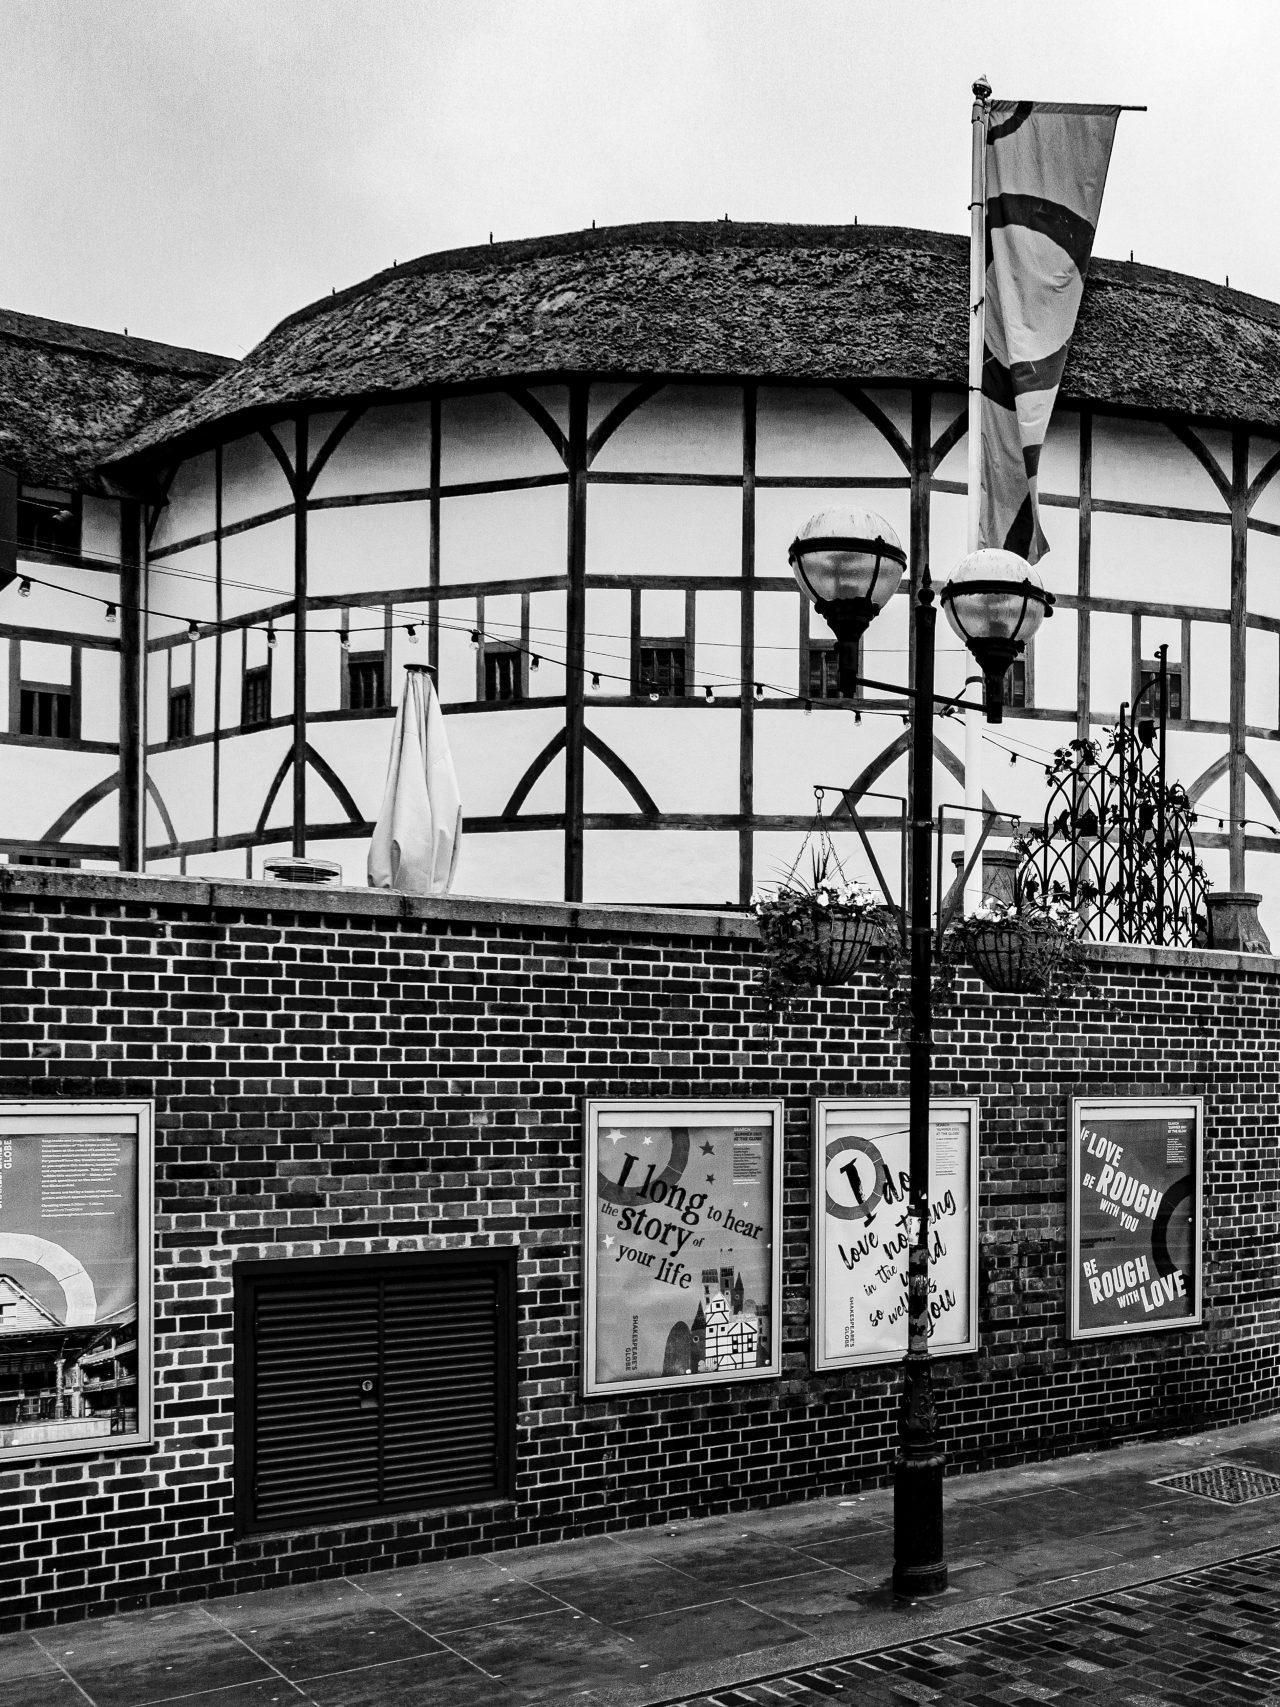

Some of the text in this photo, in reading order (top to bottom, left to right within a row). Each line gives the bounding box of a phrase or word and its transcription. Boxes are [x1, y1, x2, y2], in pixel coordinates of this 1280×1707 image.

[3, 1140, 12, 1169] GLOBE
[1080, 1126, 1124, 1168] IF LOVE
[616, 1152, 763, 1240] I long to hear
[839, 1157, 910, 1228] I do
[1082, 1163, 1163, 1221] BE ROUGH
[601, 1202, 705, 1258] the story of
[1099, 1198, 1140, 1233] WITH YOU
[615, 1244, 692, 1289] your life
[838, 1231, 879, 1271] love
[1083, 1258, 1099, 1278] BE
[863, 1284, 877, 1297] in
[875, 1264, 898, 1284] the
[1088, 1254, 1151, 1305] ROUGH
[1117, 1269, 1187, 1313] WITH LOVE
[869, 1309, 885, 1327] so
[631, 1314, 639, 1371] SHAKESPEARE'S
